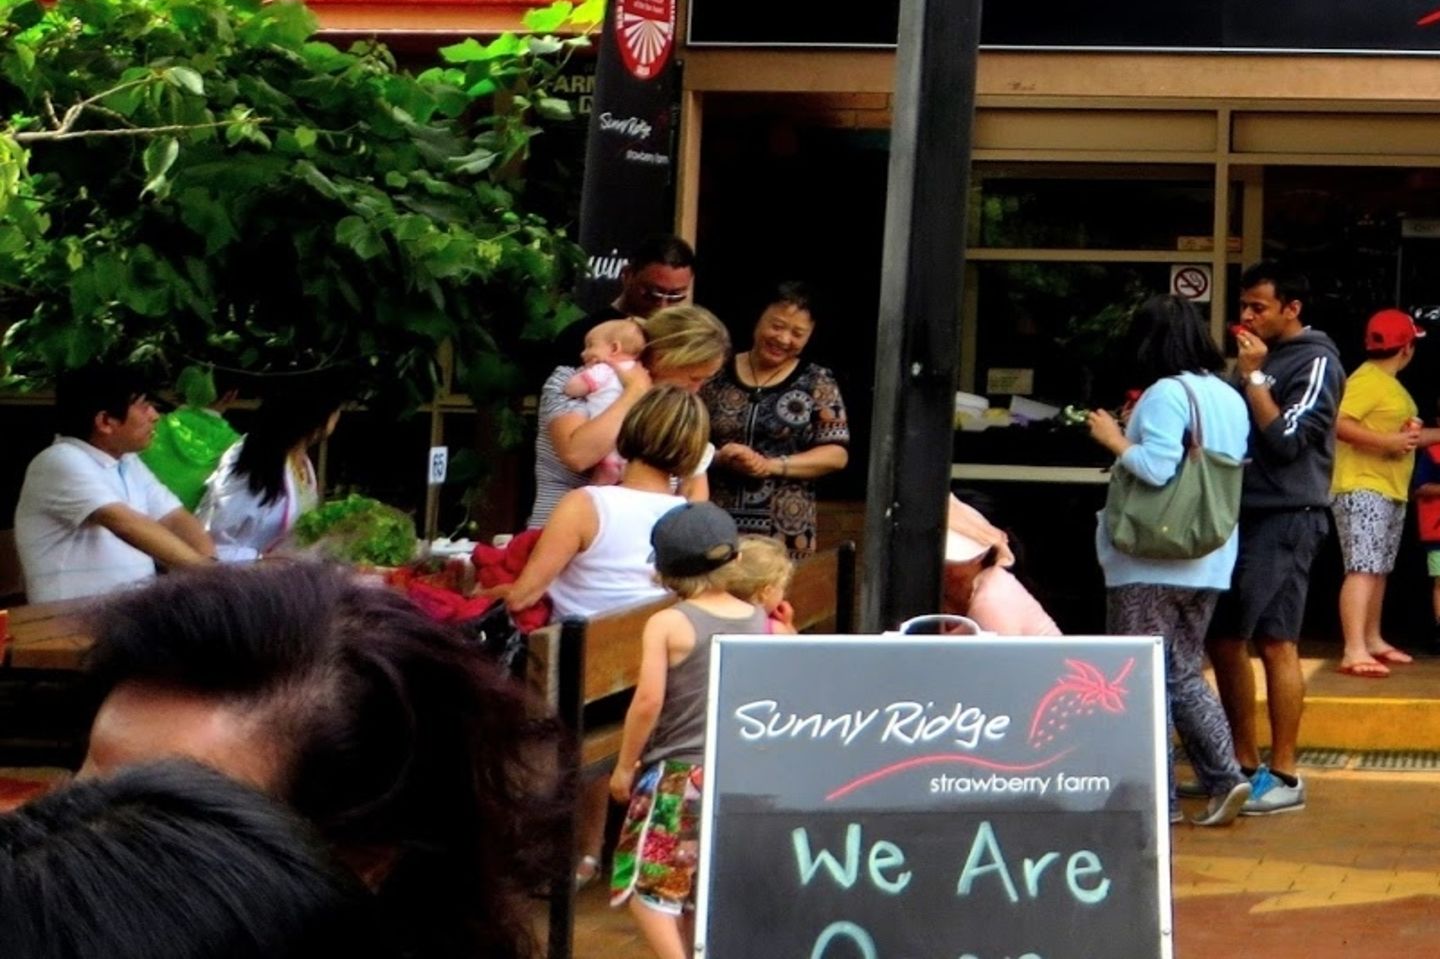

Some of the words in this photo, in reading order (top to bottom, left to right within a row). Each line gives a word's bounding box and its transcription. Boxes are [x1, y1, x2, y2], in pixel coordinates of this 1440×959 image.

[733, 700, 878, 745] Sunny
[881, 701, 1011, 748] Ridge
[929, 772, 1050, 795] strawberry
[1056, 772, 1110, 792] farm
[791, 822, 912, 894] We
[956, 820, 1111, 904] Are
